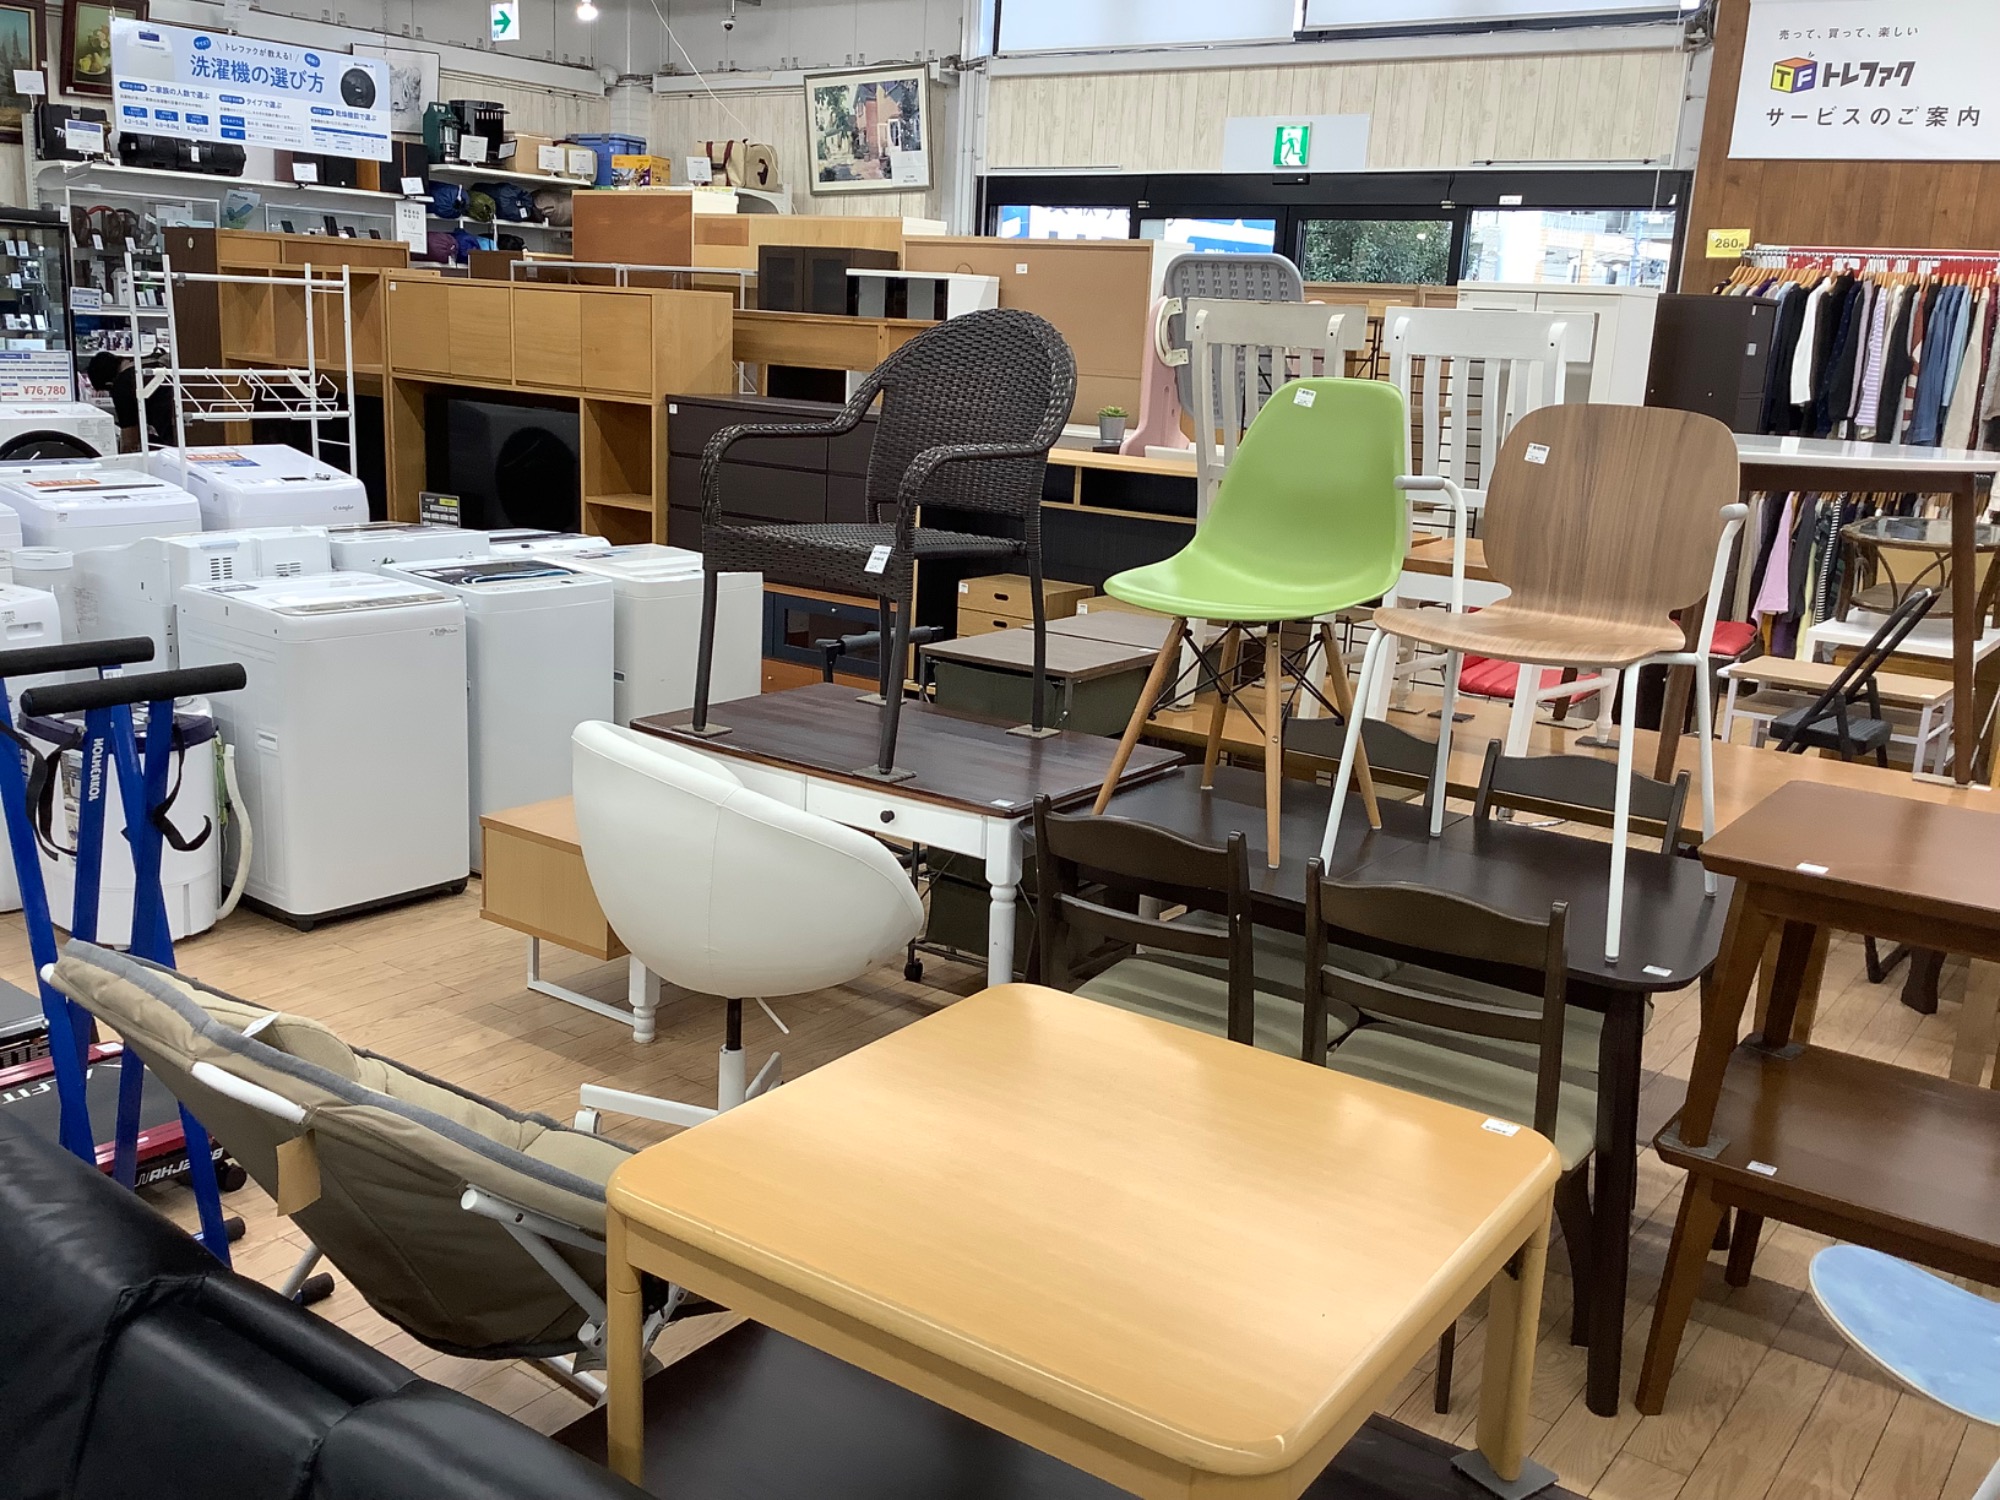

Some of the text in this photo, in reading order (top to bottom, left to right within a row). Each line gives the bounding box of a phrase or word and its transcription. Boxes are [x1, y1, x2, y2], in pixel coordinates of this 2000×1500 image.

[1779, 27, 1919, 40] 売って、買って、楽しい
[190, 54, 325, 93] 洗濯機の選び方
[1822, 61, 1916, 88] トレファク
[1766, 105, 1981, 127] サービスのご案内
[23, 385, 66, 397] ¥76,780
